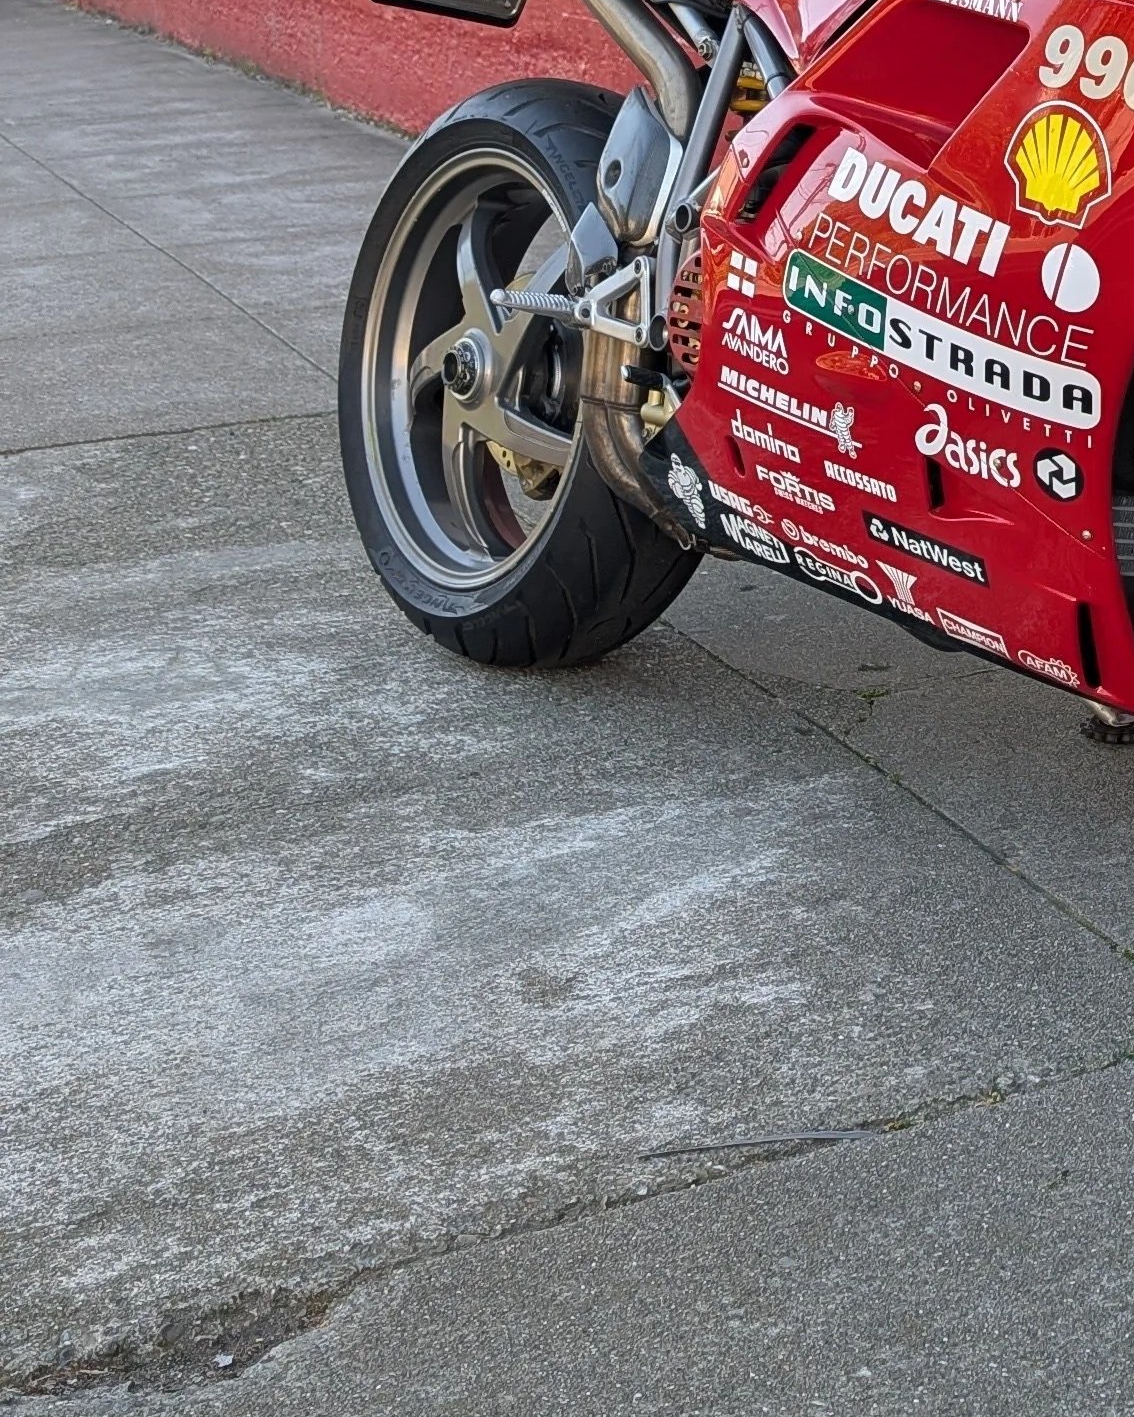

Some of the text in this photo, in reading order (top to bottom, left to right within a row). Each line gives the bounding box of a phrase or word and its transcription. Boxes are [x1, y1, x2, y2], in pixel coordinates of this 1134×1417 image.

[827, 146, 1012, 278] DUCATI
[808, 212, 1095, 368] PERFORMANCE
[720, 331, 790, 376] AVANDERO
[721, 306, 788, 359] SAIMA
[788, 264, 1094, 417] INFOSTRADA
[719, 365, 828, 427] MICHELIN
[782, 309, 1093, 449] GRUPPO OLIVETTI
[730, 408, 801, 464] domino
[707, 479, 754, 517] USAG
[755, 463, 836, 512] FORTIS
[823, 459, 898, 503] ACCOSSATO
[794, 552, 855, 589] REGINA
[798, 525, 869, 569] brembo
[890, 525, 986, 583] NatWest
[886, 594, 935, 626] YUASA
[944, 617, 1007, 654] CHAMPION
[1025, 655, 1070, 681] AFAM
